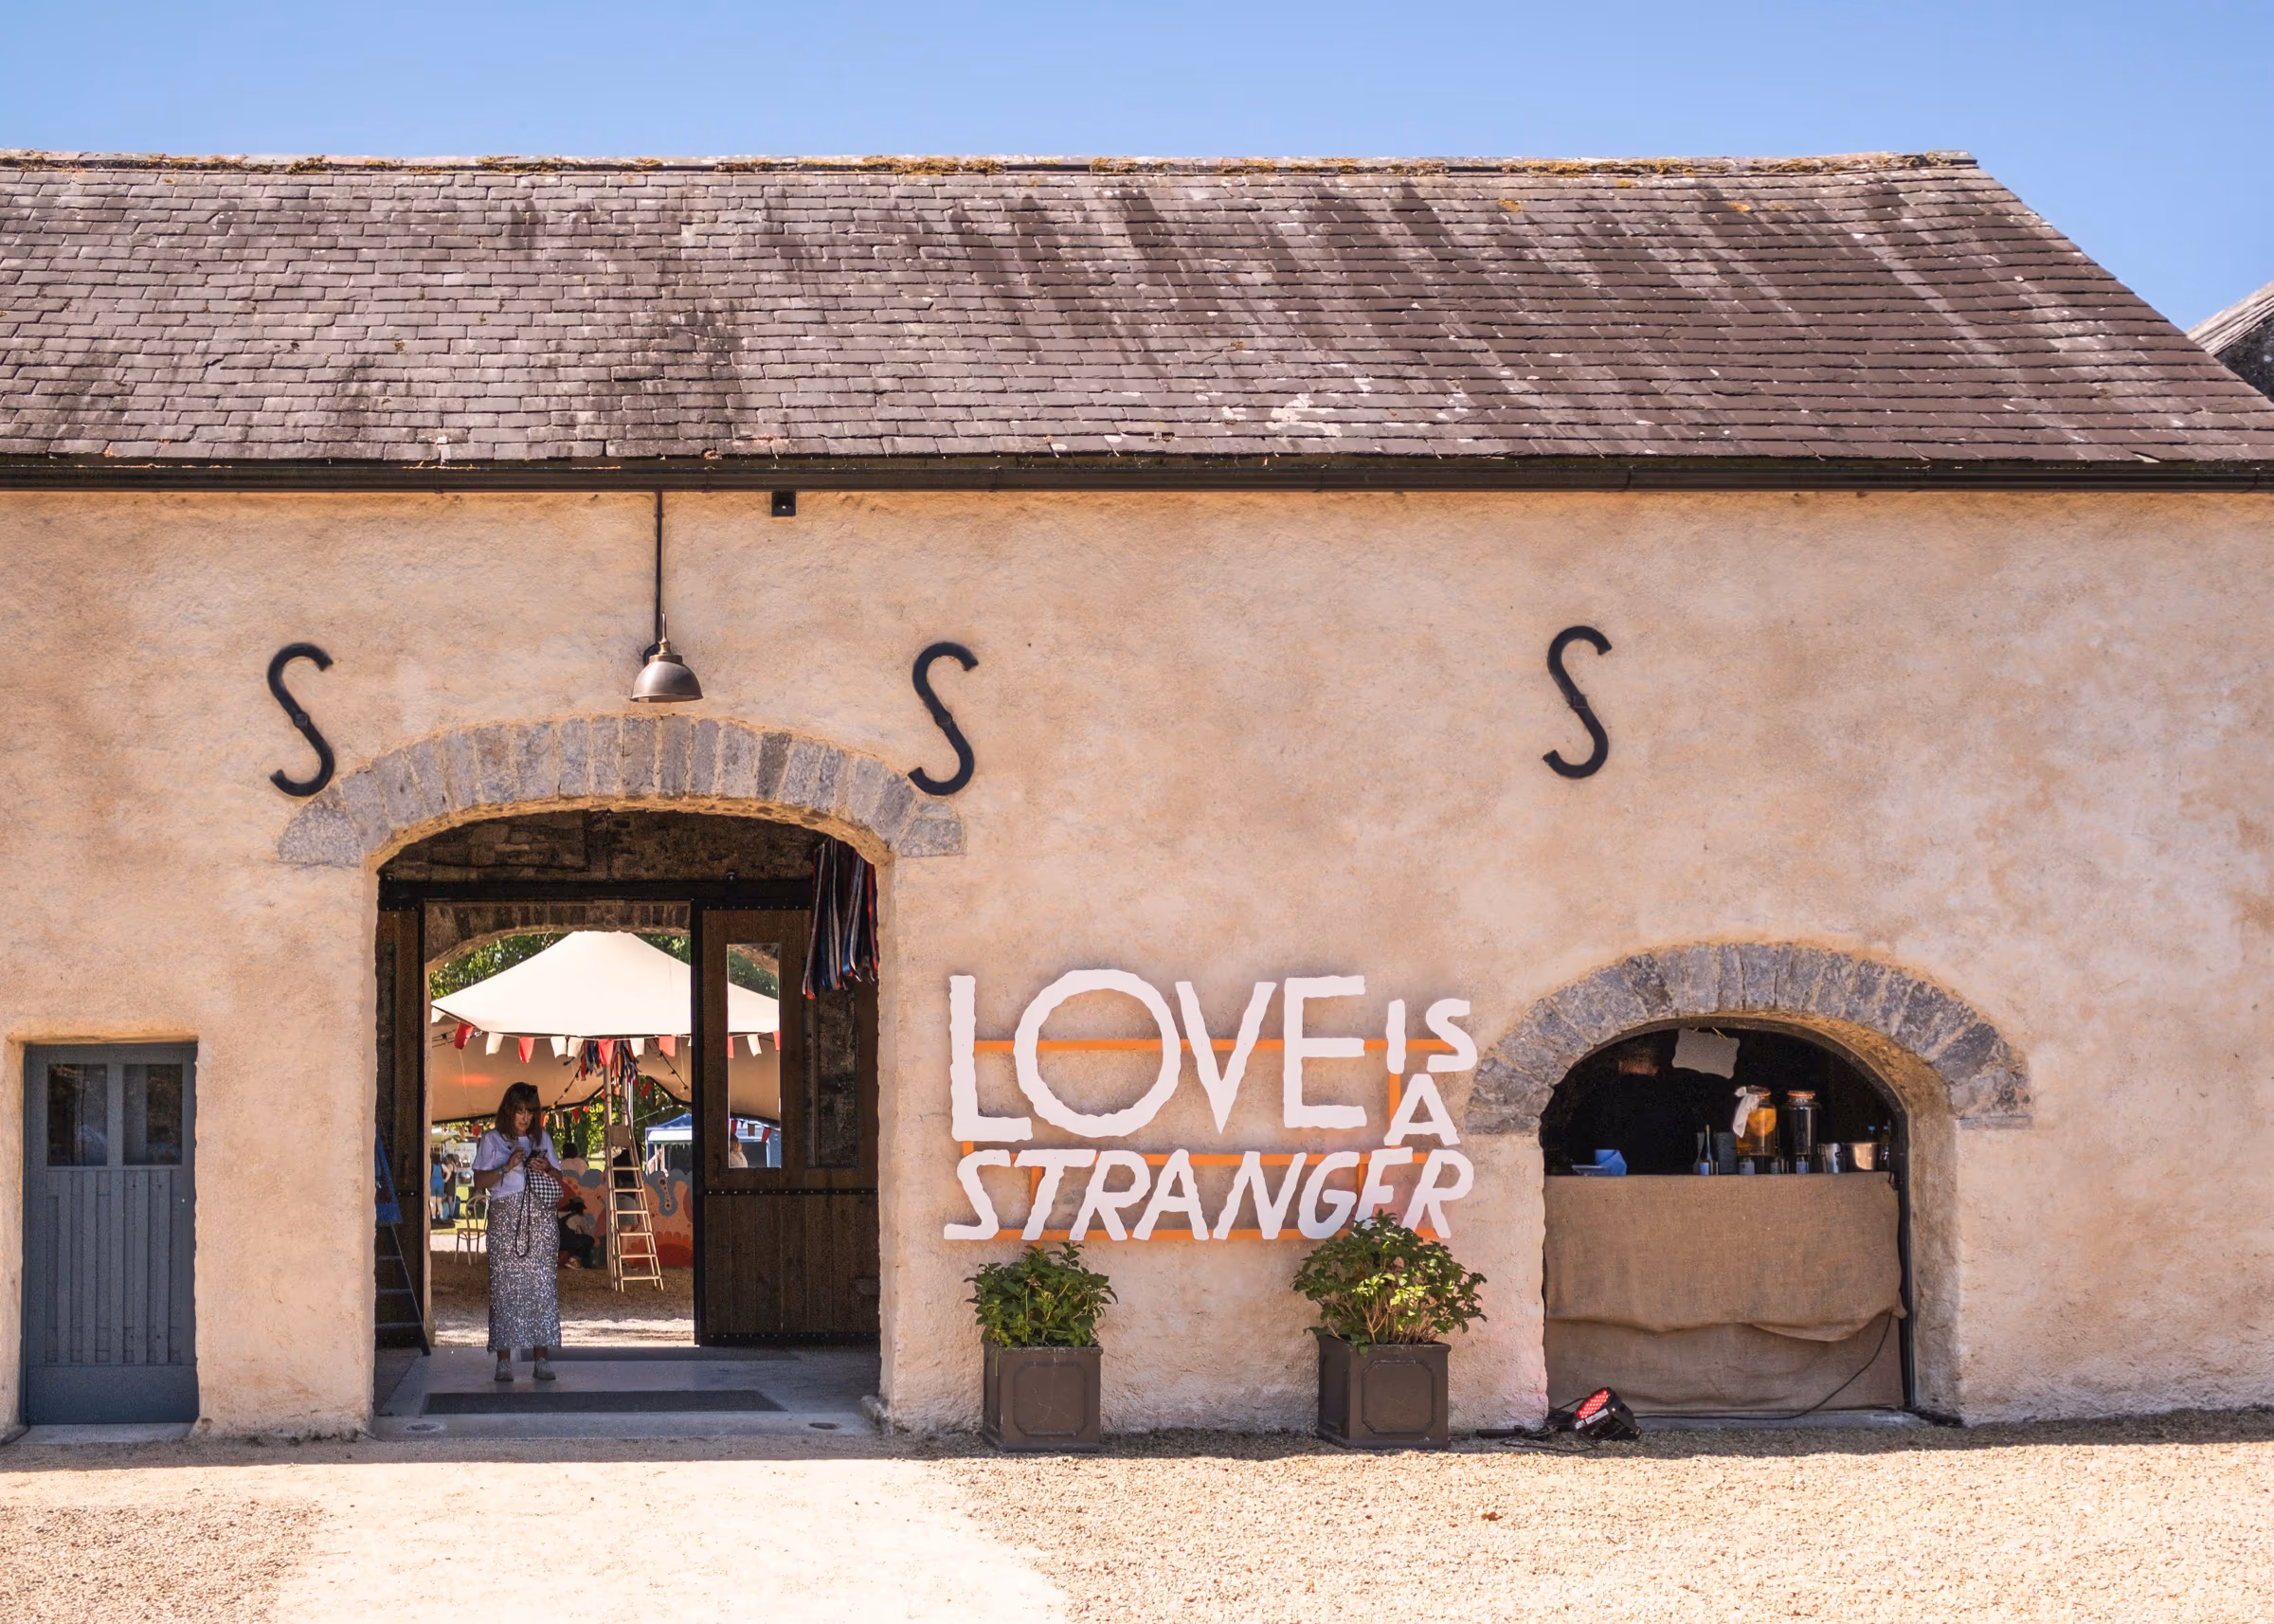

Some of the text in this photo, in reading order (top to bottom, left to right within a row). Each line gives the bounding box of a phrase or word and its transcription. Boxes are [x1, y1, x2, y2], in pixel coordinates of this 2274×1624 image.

[949, 969, 1478, 1142] LOVE IS
[1384, 1074, 1461, 1146] A
[944, 1146, 1474, 1240] STRANGER
